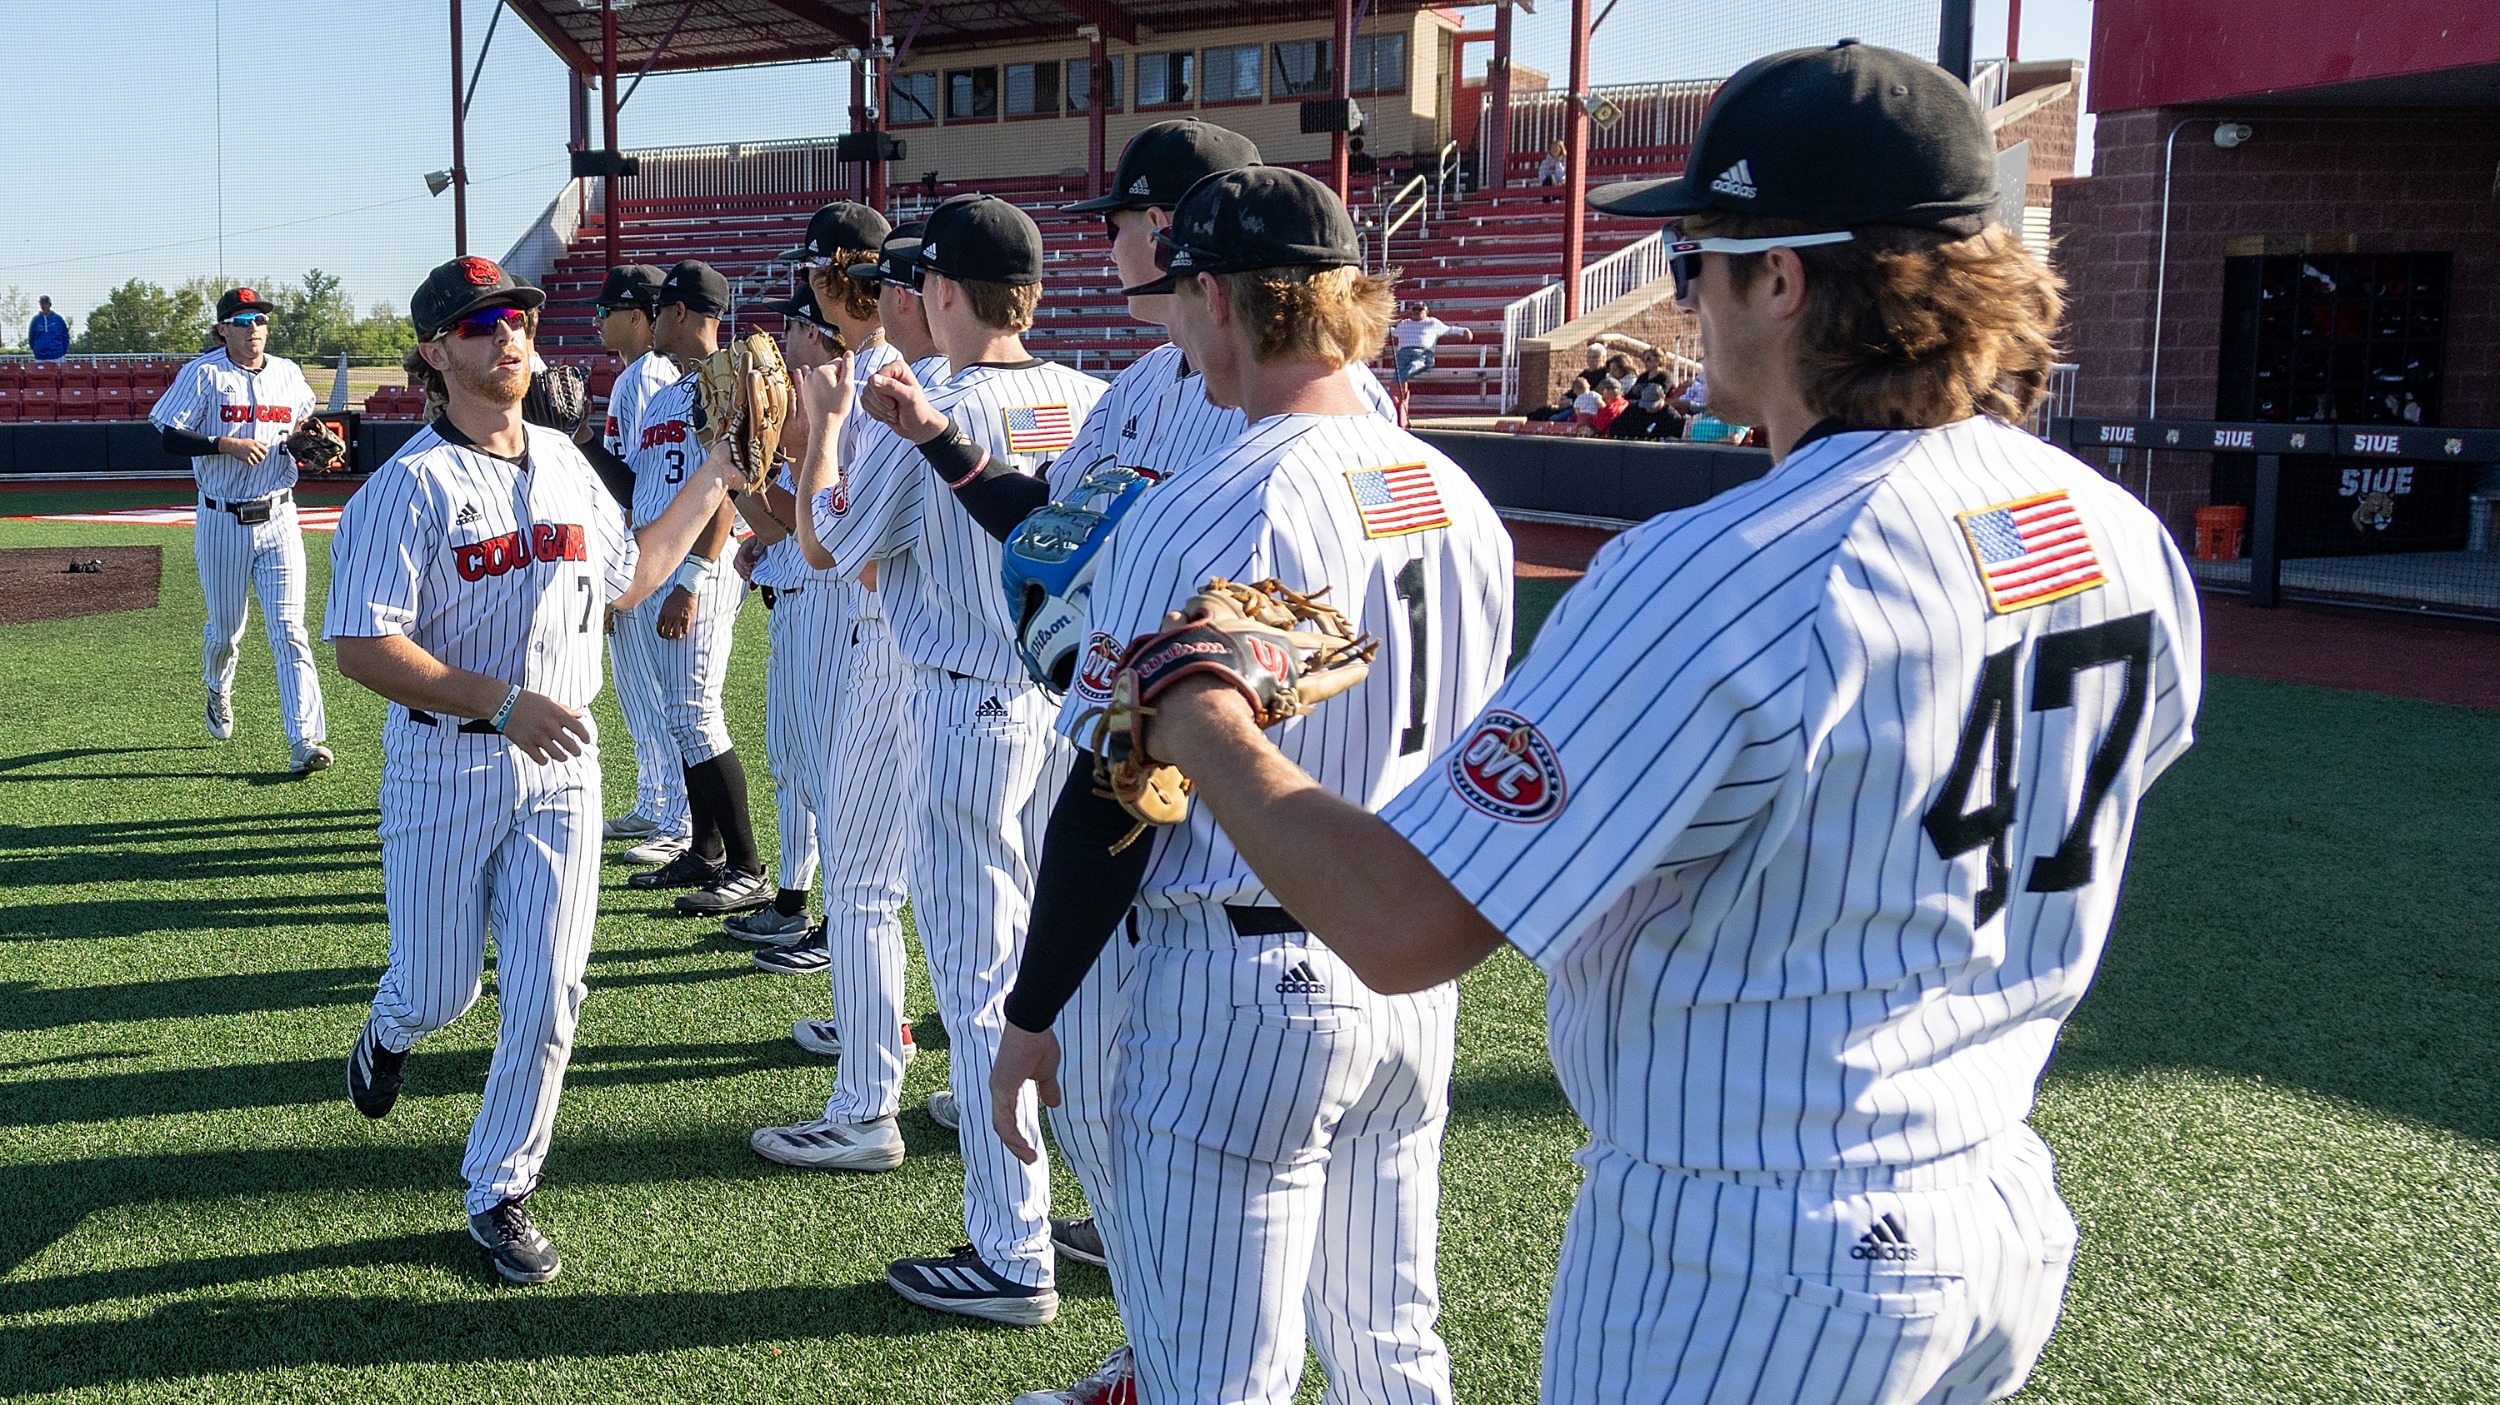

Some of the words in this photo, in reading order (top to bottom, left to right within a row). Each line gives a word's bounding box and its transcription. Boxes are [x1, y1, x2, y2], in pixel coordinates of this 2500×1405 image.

[1711, 179, 1757, 198] adidas
[220, 404, 293, 423] COUGARS
[2100, 426, 2135, 443] SIUE
[2214, 430, 2253, 448] SIUE
[2354, 434, 2399, 453] SIUE
[665, 450, 685, 484] 3
[2338, 466, 2415, 496] SIUE
[456, 512, 483, 526] adidas
[578, 576, 594, 634] 7
[1030, 613, 1072, 661] Wilson
[1394, 558, 1428, 757] 1
[1465, 731, 1541, 801] OVC
[1923, 610, 2157, 930] 47
[1275, 980, 1327, 994] adidas
[1850, 1244, 1919, 1262] adidas
